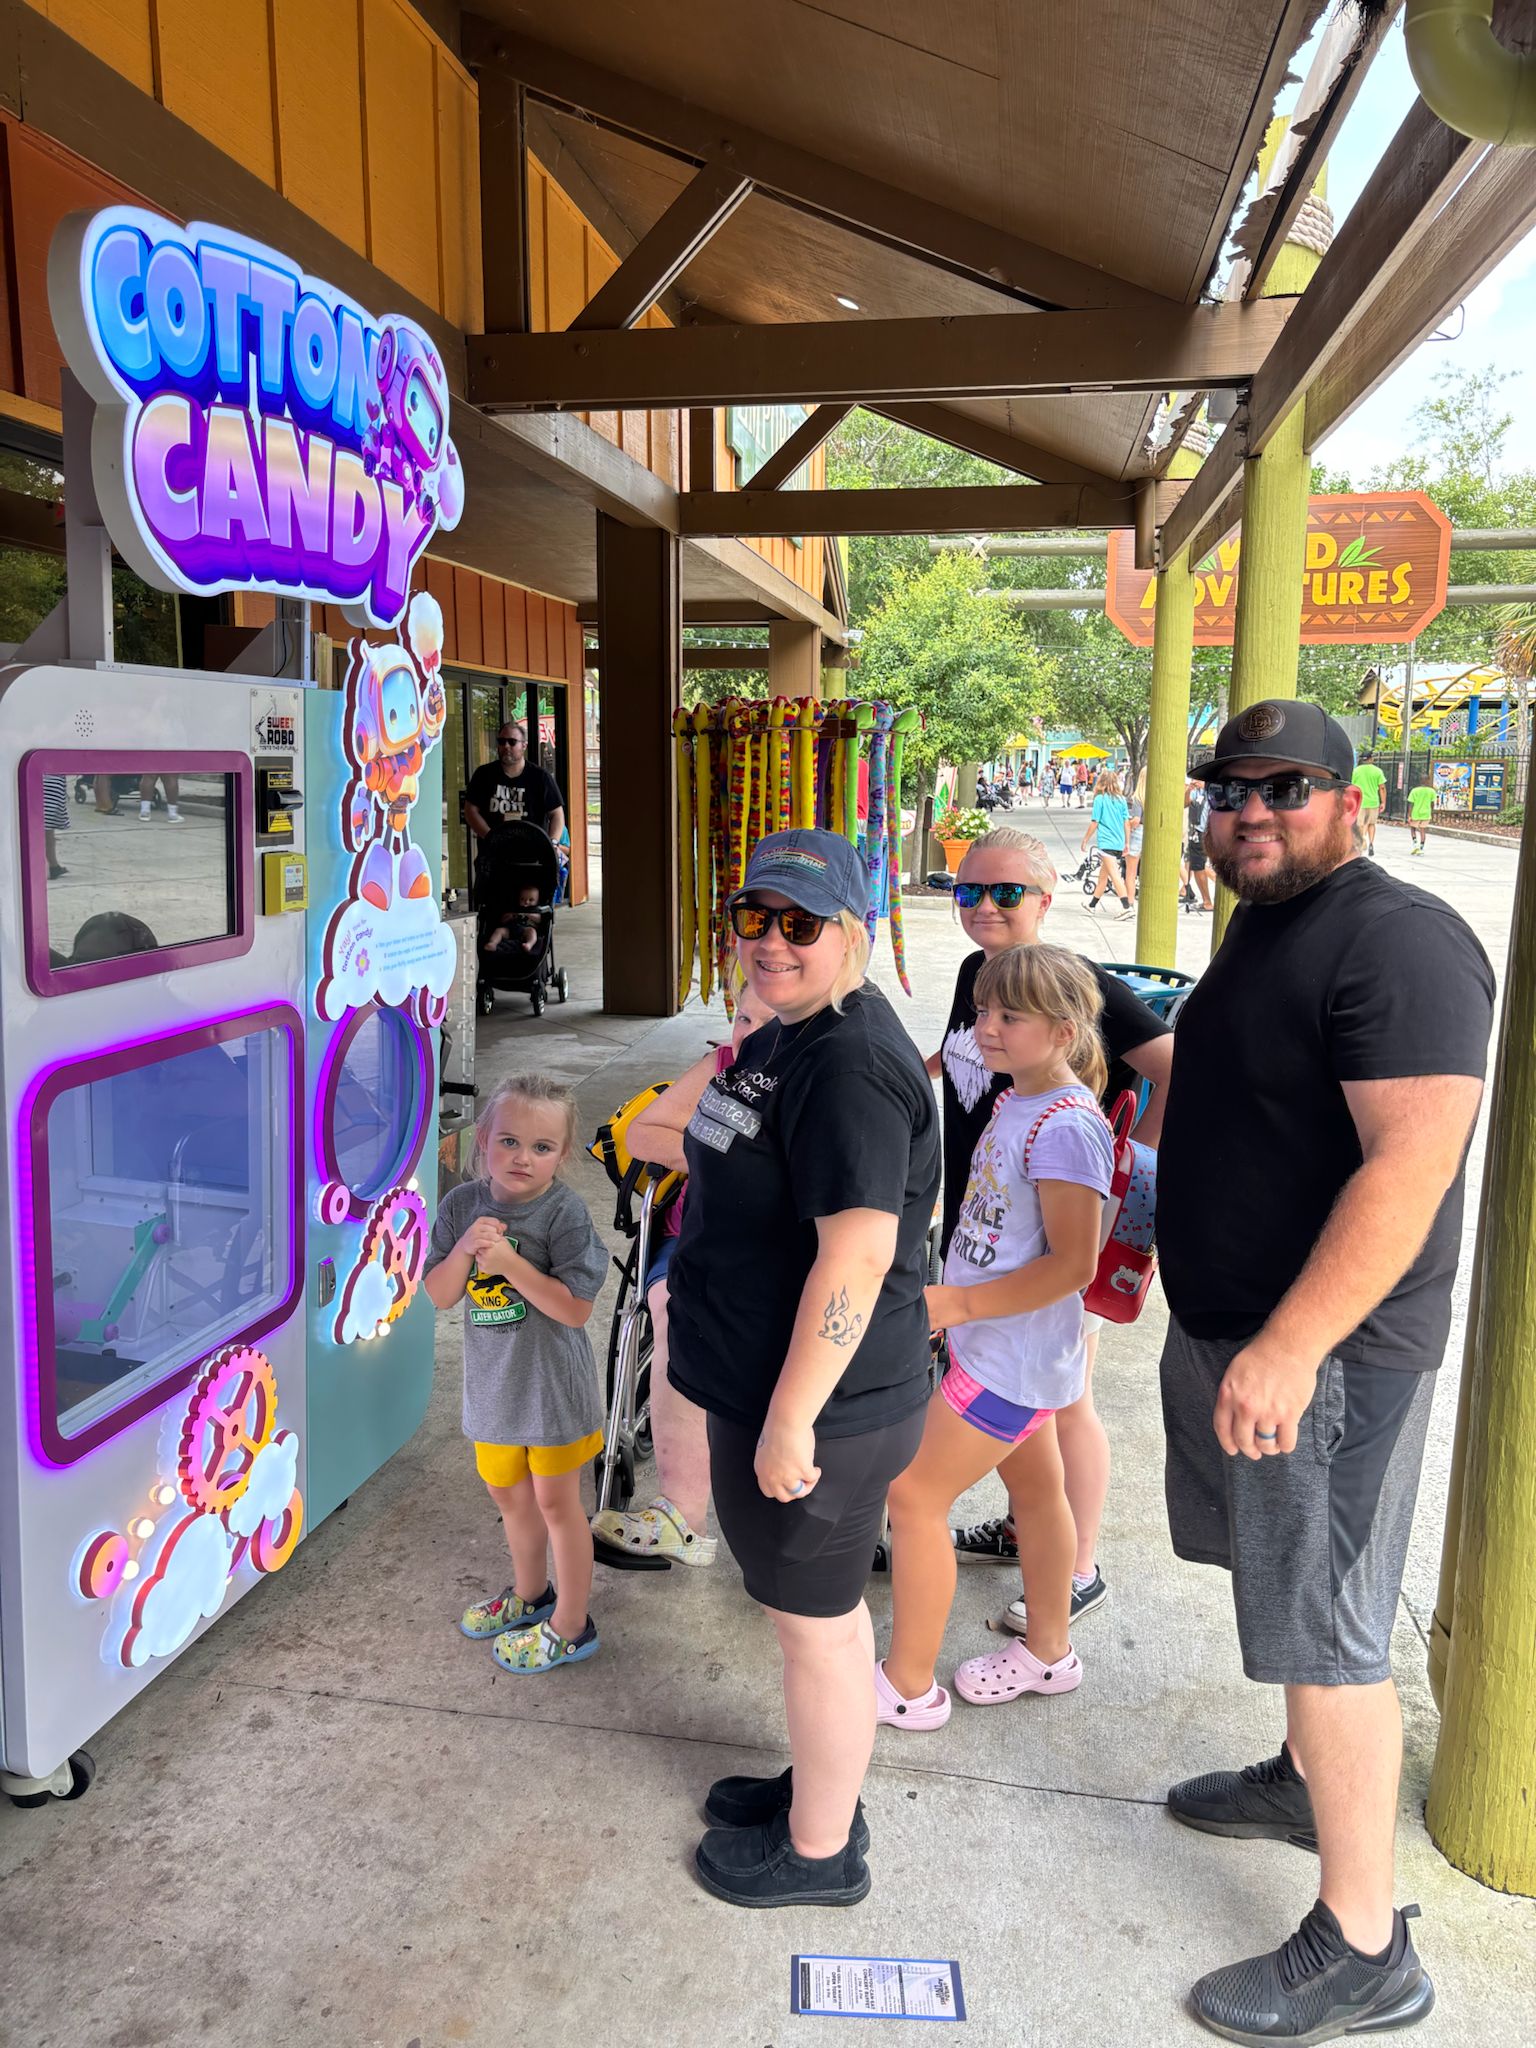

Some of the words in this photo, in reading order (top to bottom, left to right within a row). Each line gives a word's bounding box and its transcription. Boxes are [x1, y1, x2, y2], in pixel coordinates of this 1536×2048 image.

[91, 224, 382, 435] COTTON
[132, 392, 434, 597] CANDY
[267, 716, 296, 729] SWEET
[267, 729, 294, 745] ROBO
[490, 797, 511, 815] DO
[964, 1191, 1005, 1230] RULE
[954, 1228, 996, 1268] ORLD
[480, 1295, 502, 1308] XING
[492, 1308, 517, 1321] GATOR
